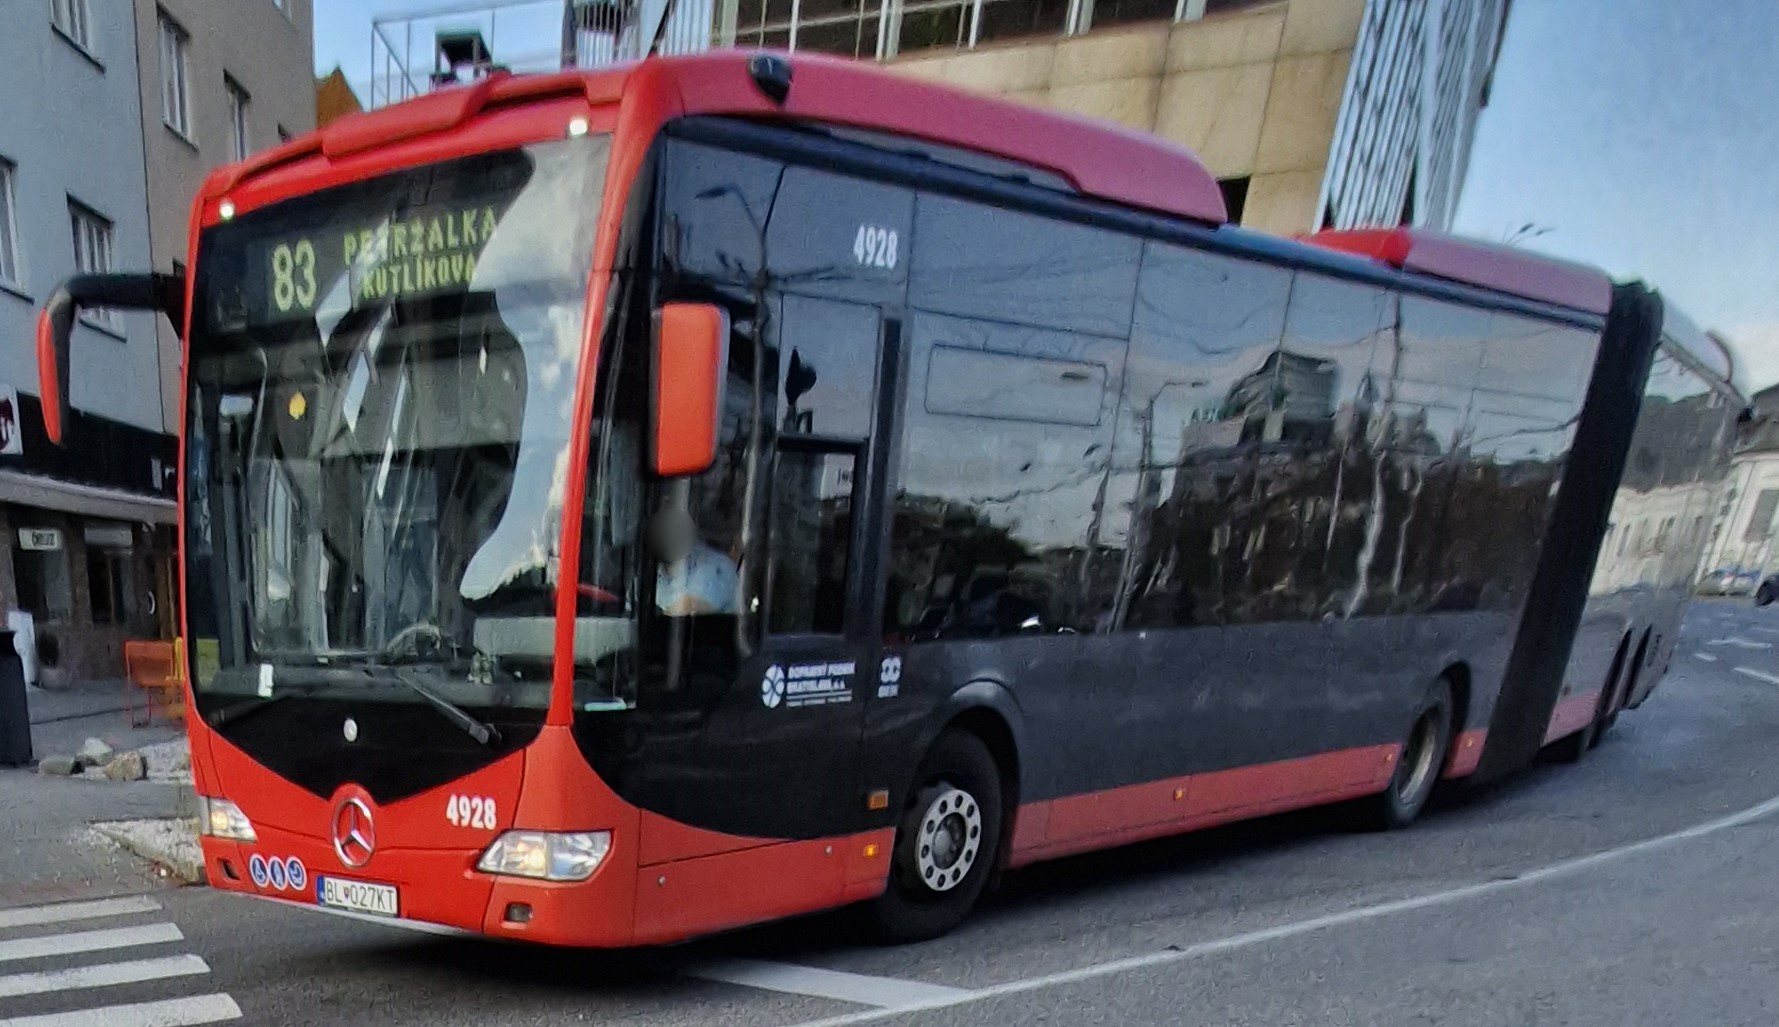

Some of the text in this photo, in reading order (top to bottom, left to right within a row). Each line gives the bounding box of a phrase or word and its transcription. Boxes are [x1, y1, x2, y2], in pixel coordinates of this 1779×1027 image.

[853, 225, 898, 270] 4928
[272, 239, 318, 312] 83
[446, 794, 497, 830] 4928
